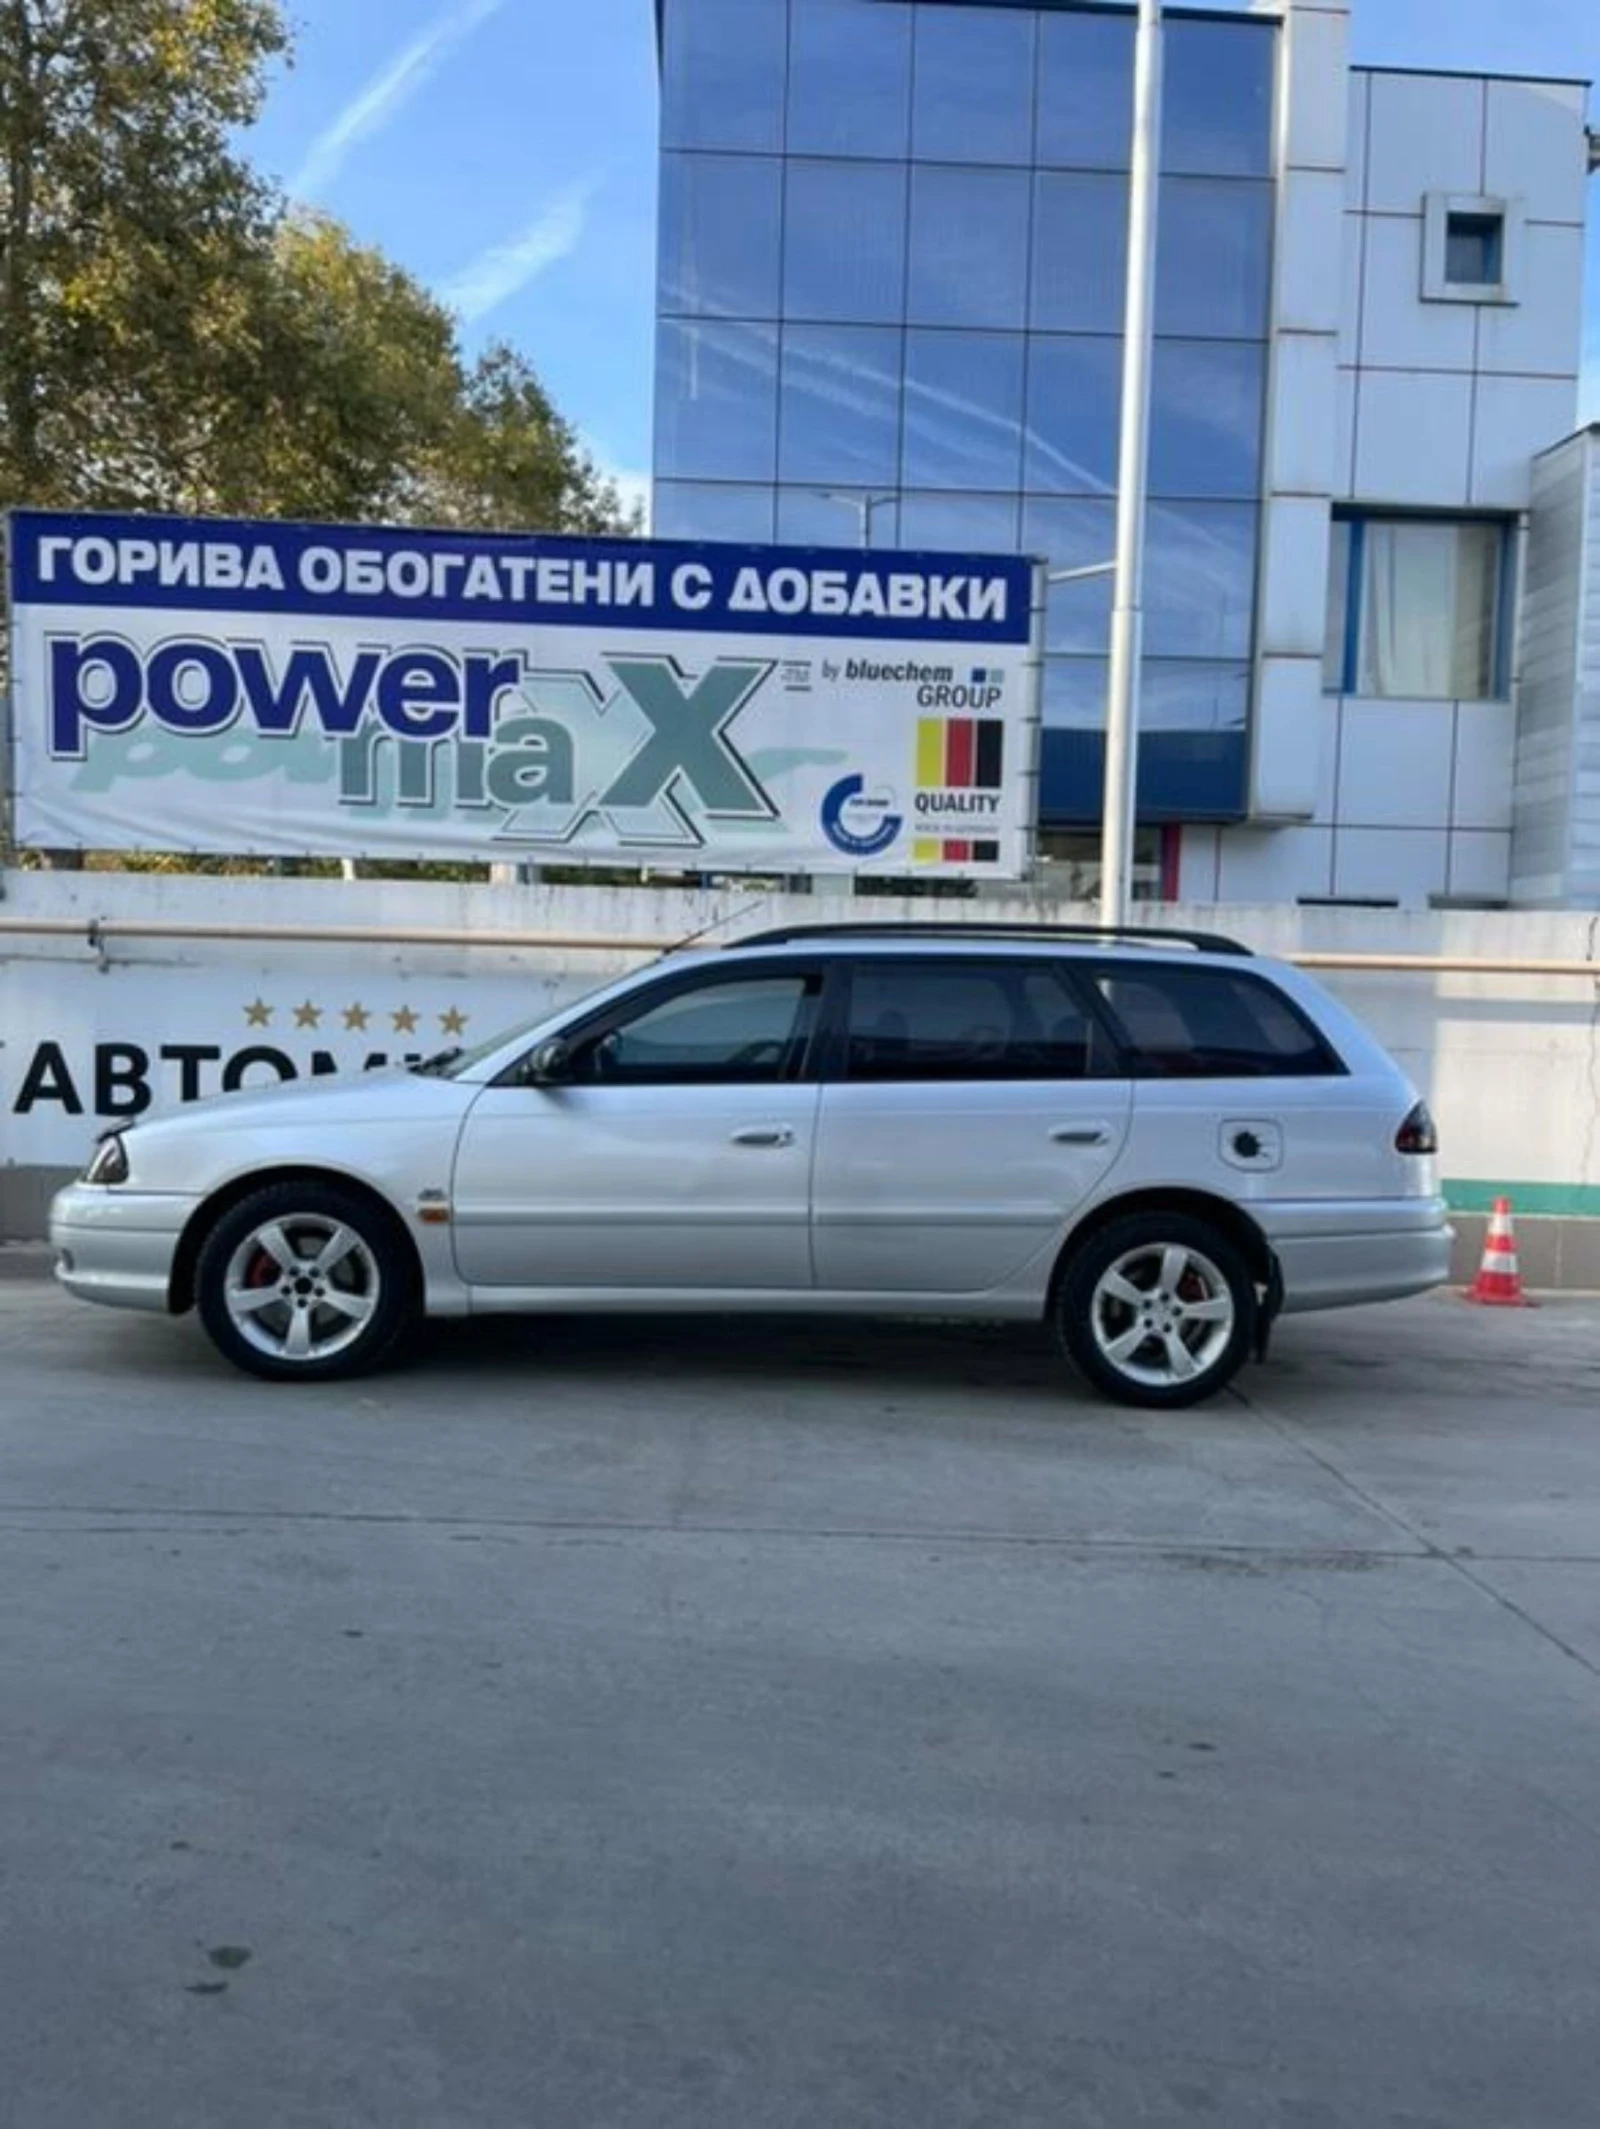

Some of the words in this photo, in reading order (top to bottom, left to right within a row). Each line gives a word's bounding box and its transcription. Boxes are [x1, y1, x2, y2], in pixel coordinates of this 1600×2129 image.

[38, 537, 285, 591] ГОРИВА
[299, 547, 655, 608] ОБОГАТЕНИ
[671, 563, 714, 611] С
[728, 567, 1008, 622] ДОБАВКИ
[821, 658, 841, 682] by
[845, 658, 953, 683] bluechem
[45, 631, 527, 762] power
[916, 684, 1002, 709] GROUP
[914, 792, 1000, 815] QUALITY
[13, 1040, 421, 1117] АВТО
